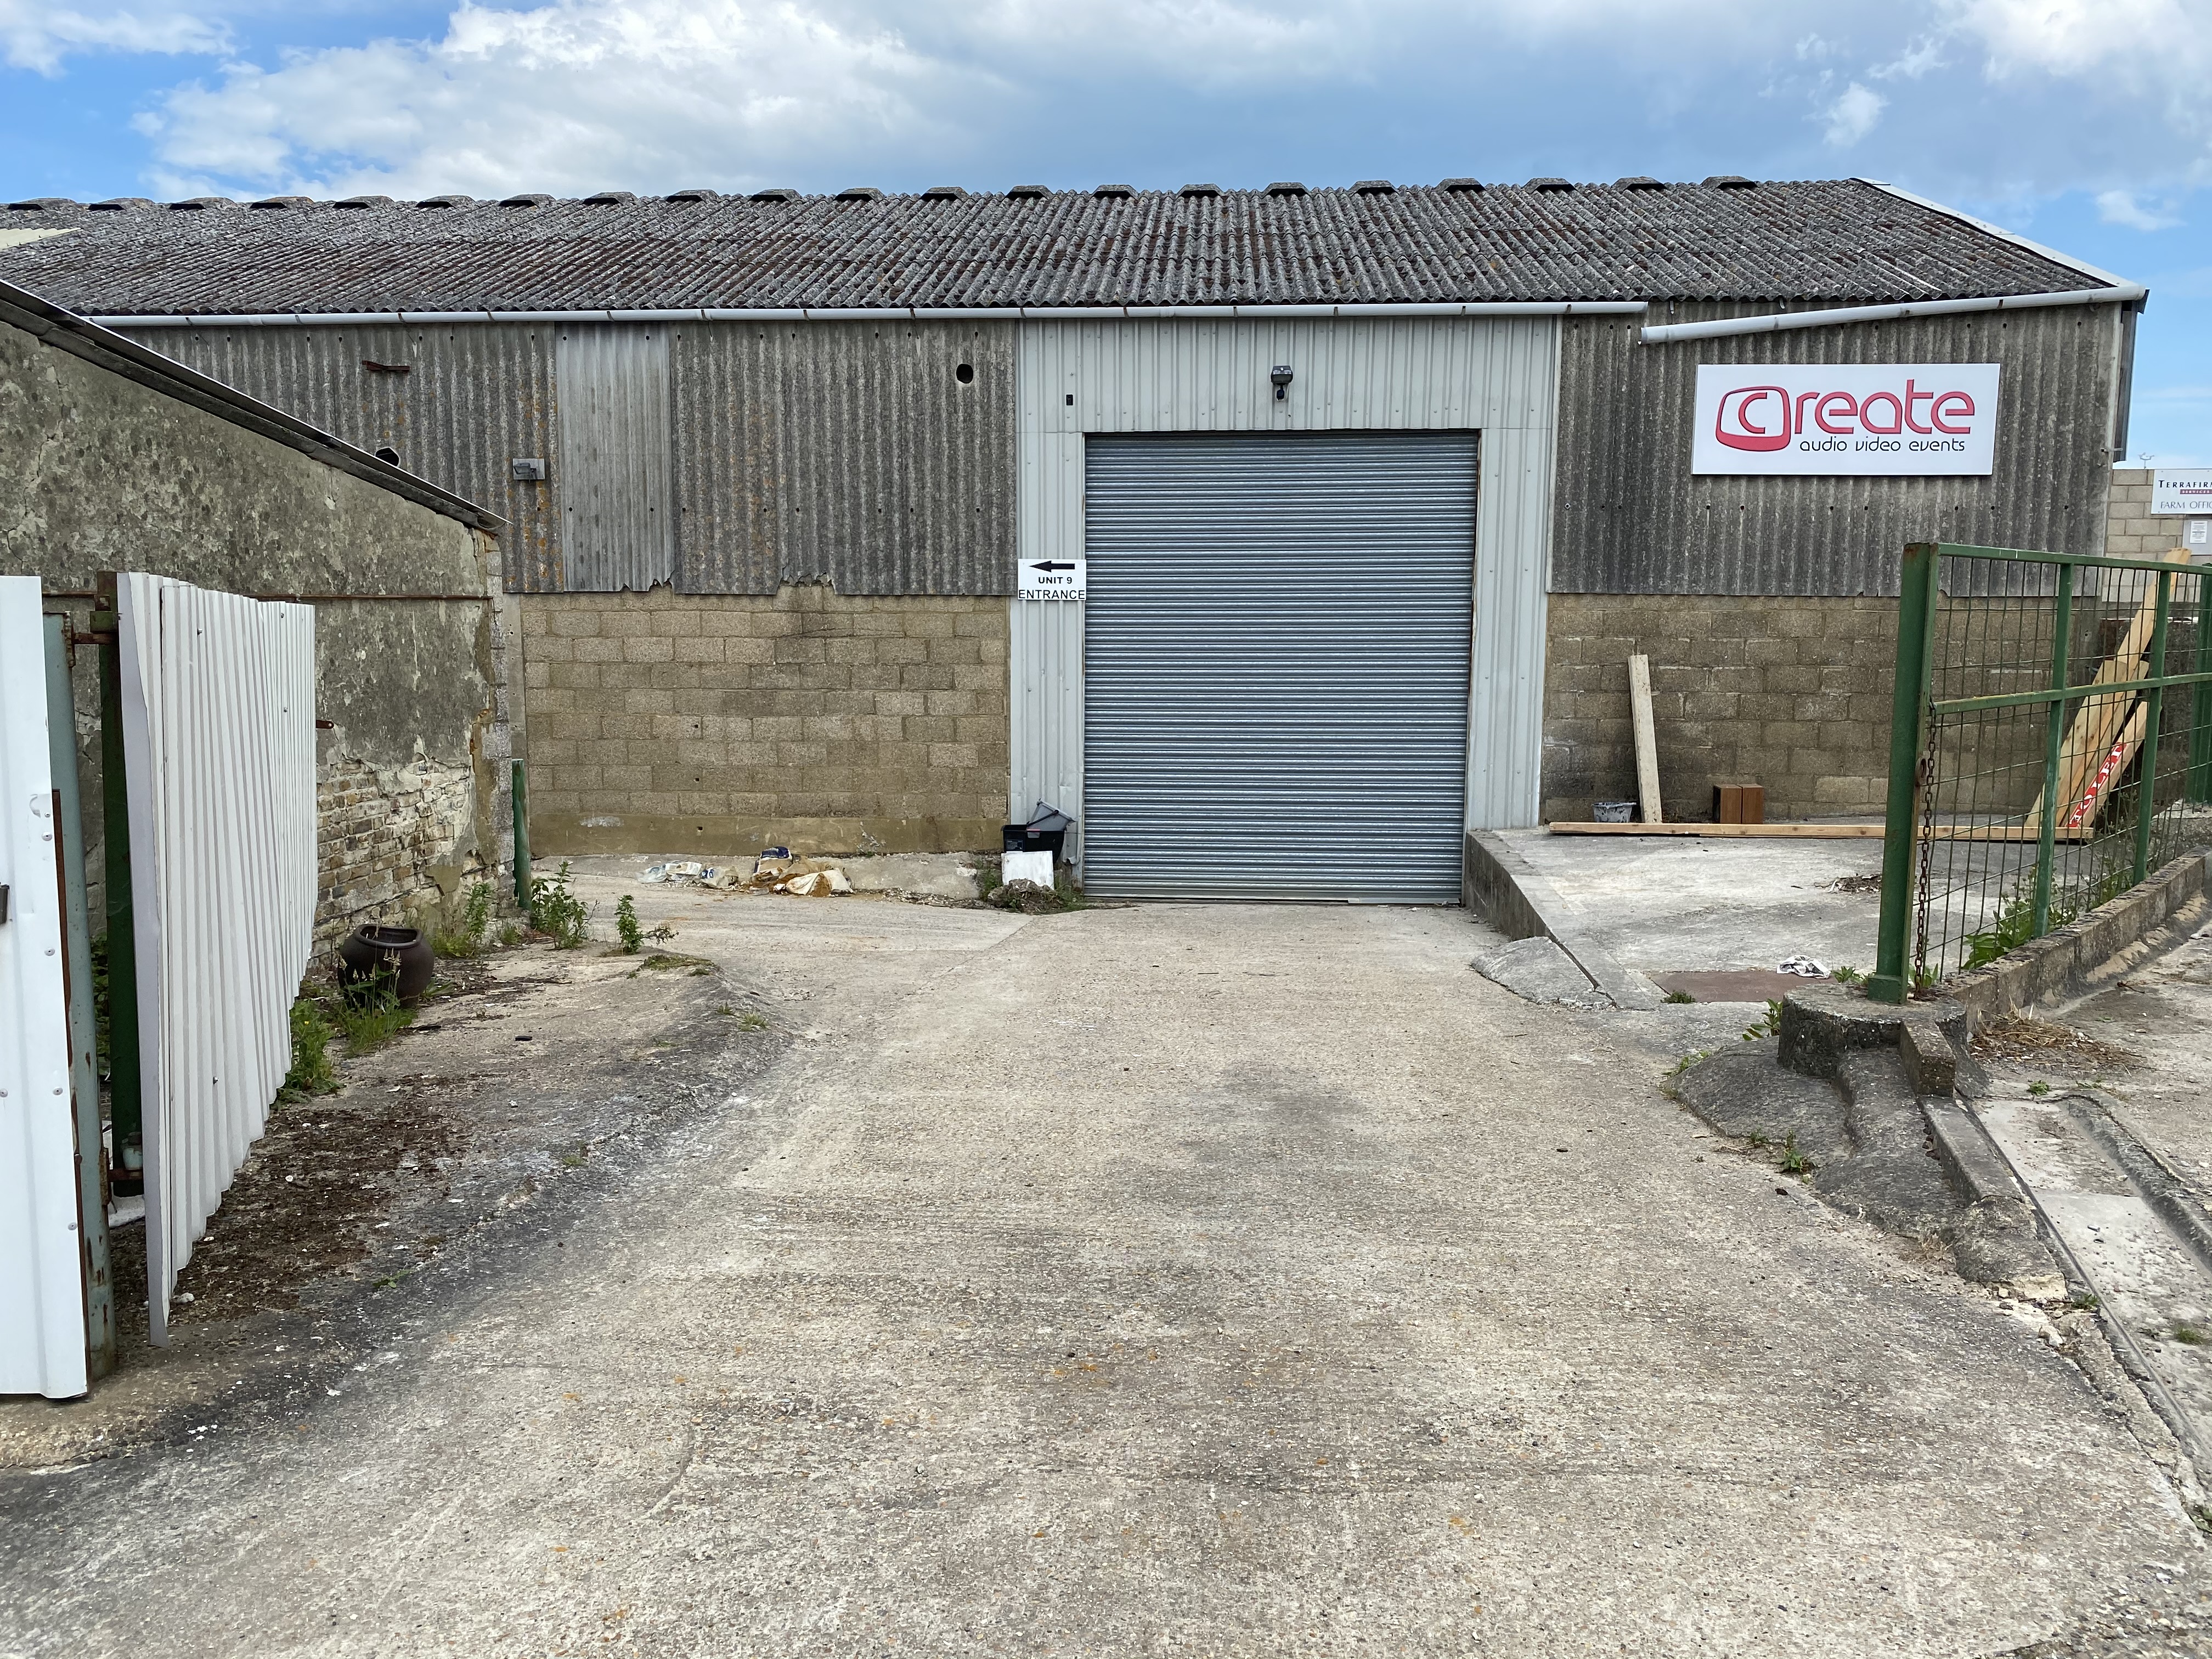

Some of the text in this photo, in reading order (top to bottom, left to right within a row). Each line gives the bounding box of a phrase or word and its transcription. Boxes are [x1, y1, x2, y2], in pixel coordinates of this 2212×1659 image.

[1800, 436, 1965, 452] audio video events
[2160, 501, 2185, 509] FARM
[1018, 589, 1085, 600] ENTRANCE
[2069, 746, 2123, 825] TO LET
